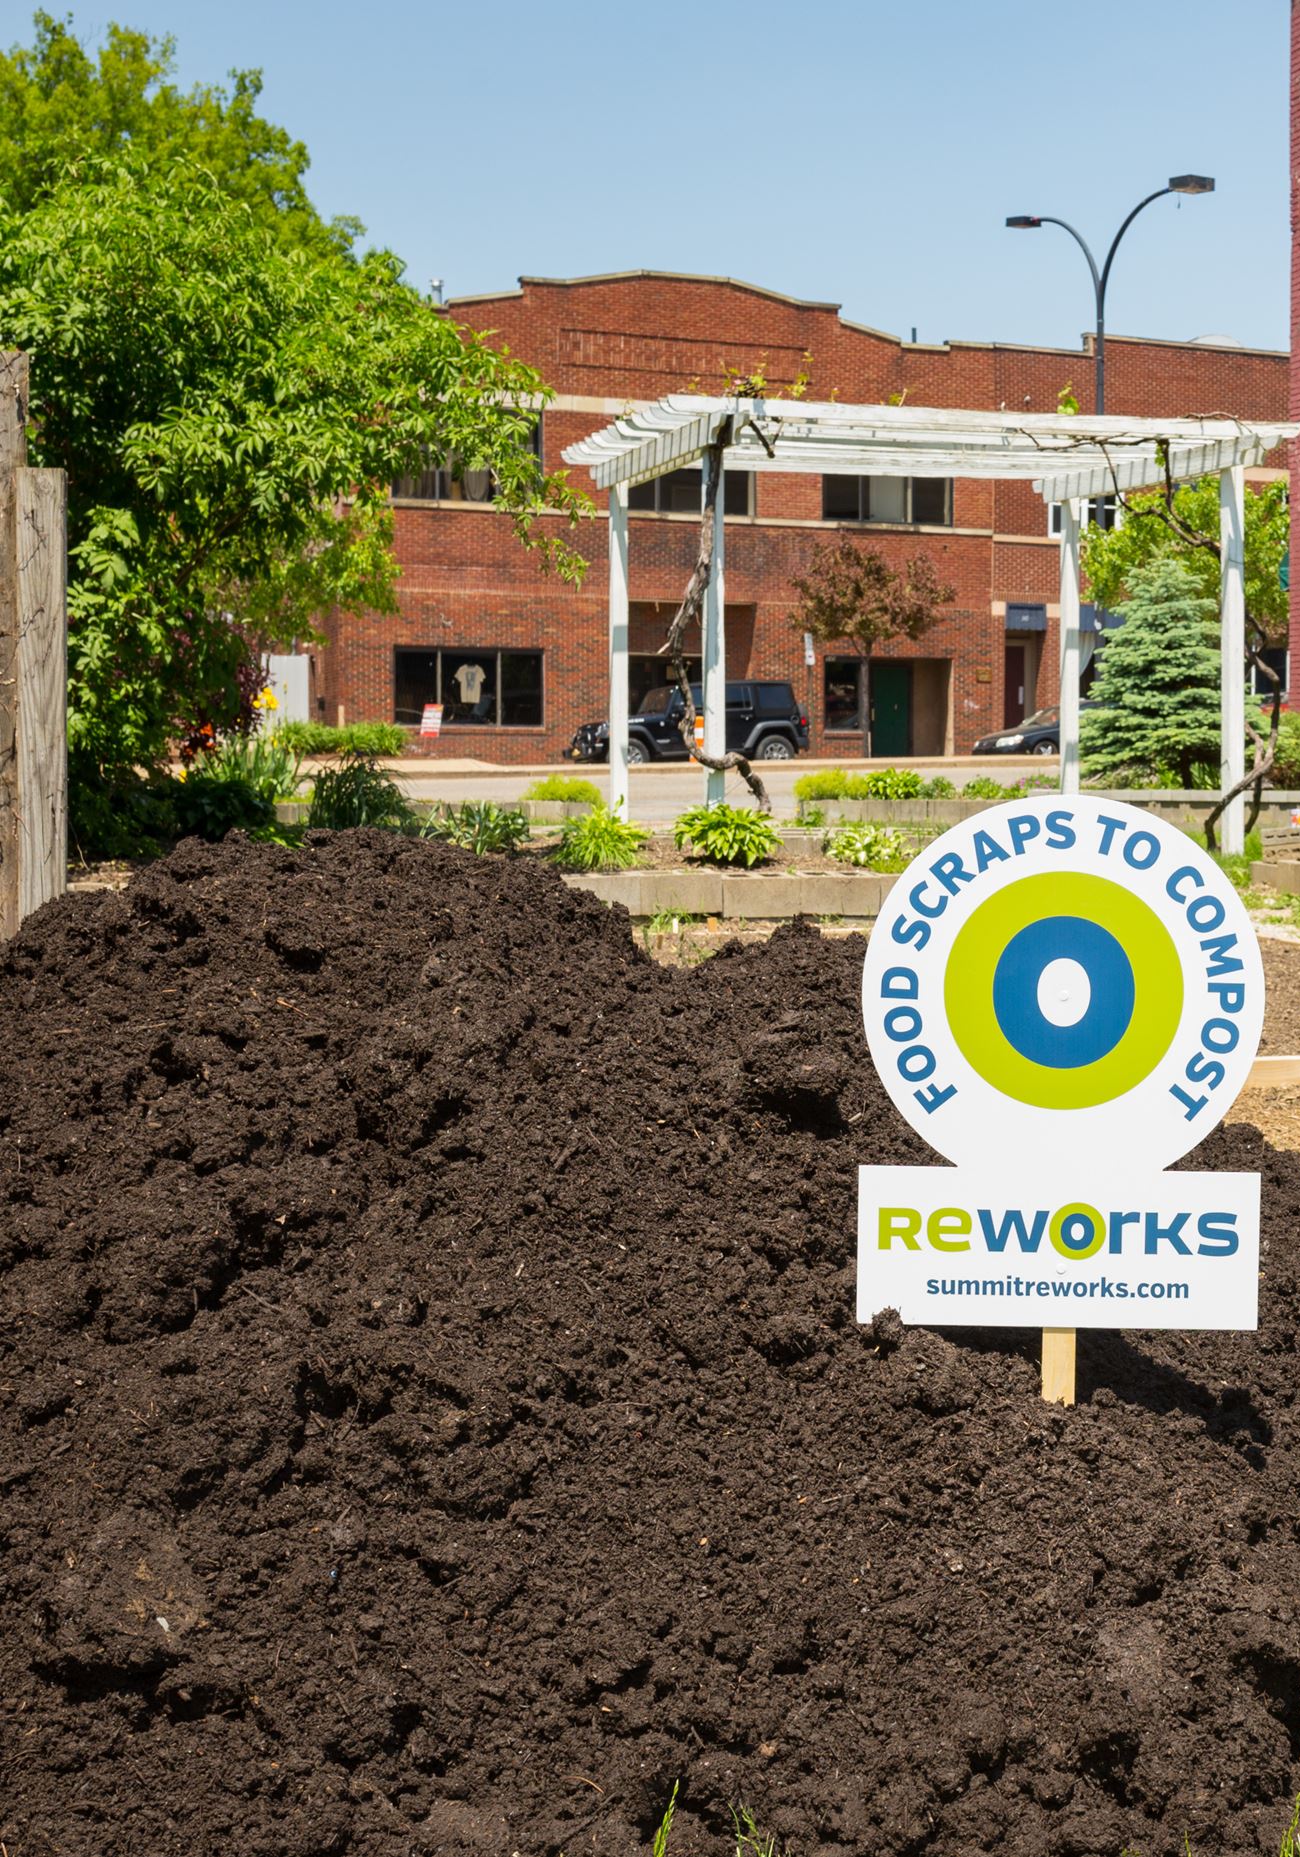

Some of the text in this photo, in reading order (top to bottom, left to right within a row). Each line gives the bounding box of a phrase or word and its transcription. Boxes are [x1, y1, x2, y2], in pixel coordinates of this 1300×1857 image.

[881, 810, 1245, 1122] FOOD SCRAPS TO COMPOST
[926, 1275, 1190, 1299] summitreworks.com
